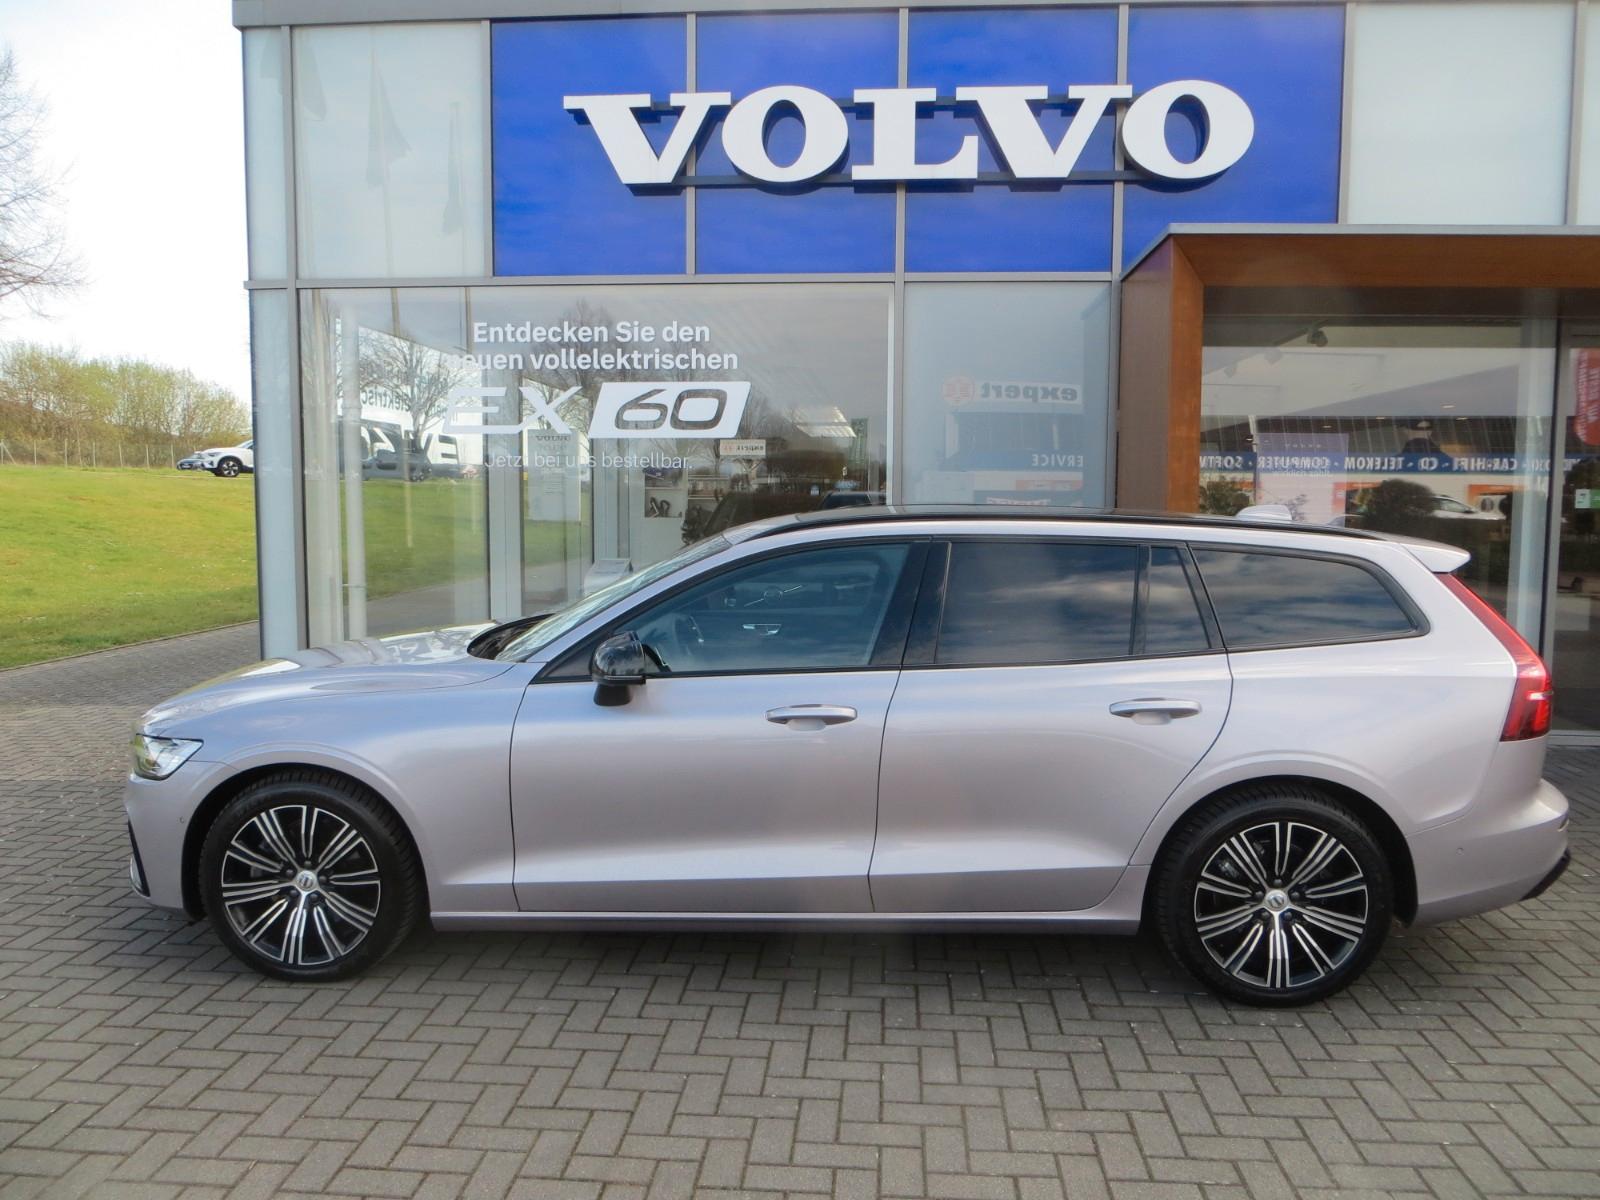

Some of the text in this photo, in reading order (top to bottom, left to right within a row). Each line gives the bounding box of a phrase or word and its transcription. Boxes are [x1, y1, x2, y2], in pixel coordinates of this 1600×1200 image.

[563, 80, 1255, 184] VOLVO
[473, 320, 710, 343] Entdecken Sie den
[530, 347, 738, 370] vollelektrischen
[614, 388, 728, 431] 60
[534, 452, 560, 468] bei
[602, 451, 693, 469] bestellbar.
